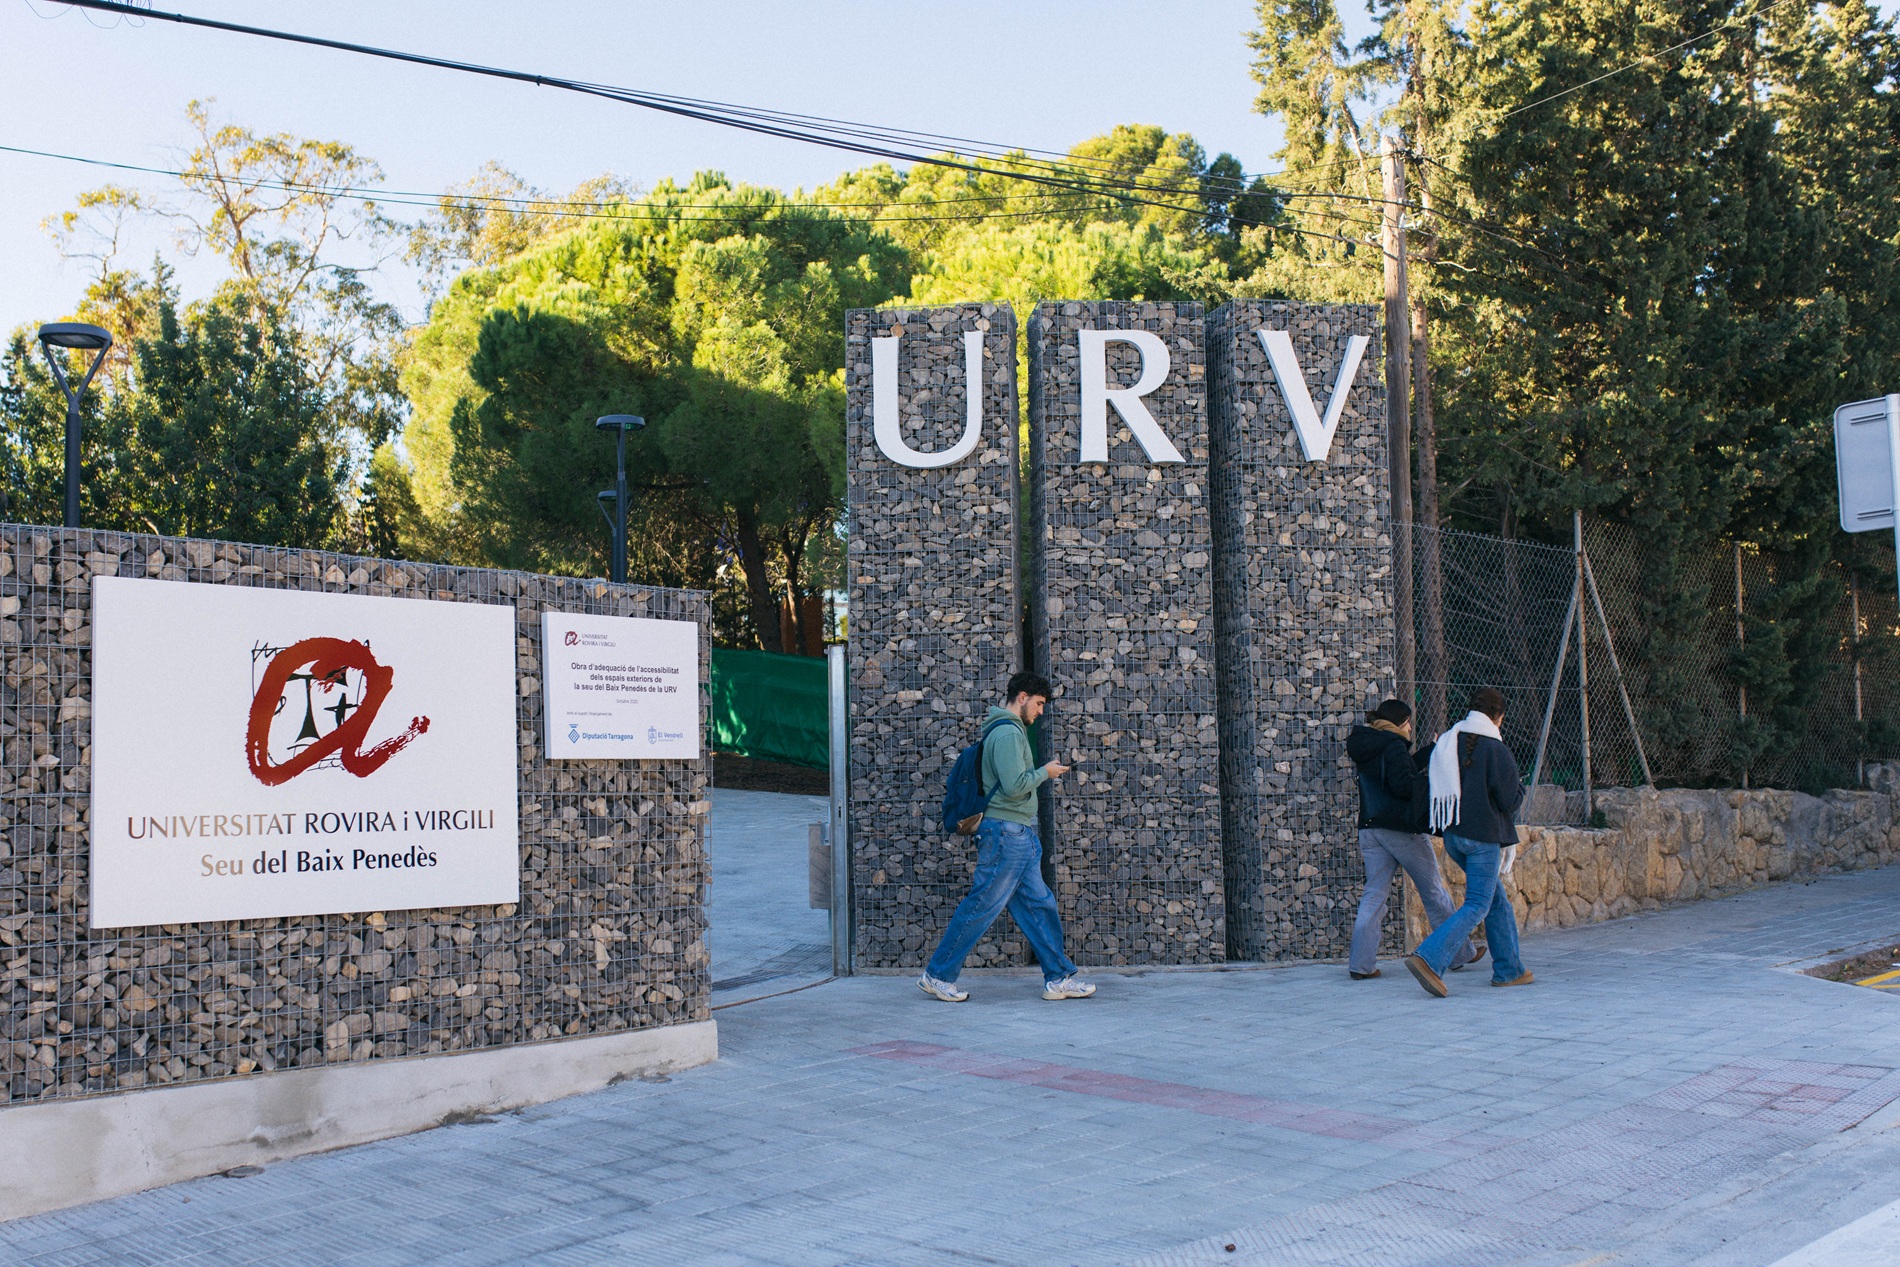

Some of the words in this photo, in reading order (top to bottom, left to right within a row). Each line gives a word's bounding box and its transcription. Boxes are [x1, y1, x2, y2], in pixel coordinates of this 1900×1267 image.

[571, 662, 587, 670] Obra
[589, 663, 626, 673] d'adequació
[637, 665, 679, 674] l'accessibilitat
[590, 673, 604, 681] dels
[605, 674, 625, 683] espais
[621, 684, 647, 693] Penedès
[582, 732, 607, 740] Diputació
[608, 733, 634, 741] Tarragona
[127, 812, 297, 840] UNIVERSITAT
[304, 810, 395, 835] ROVIRA
[403, 811, 409, 832] i
[414, 808, 495, 832] VIRGILI
[200, 854, 244, 878] Seu
[252, 850, 287, 875] del
[297, 848, 344, 874] Baix
[353, 845, 438, 871] Penedès
